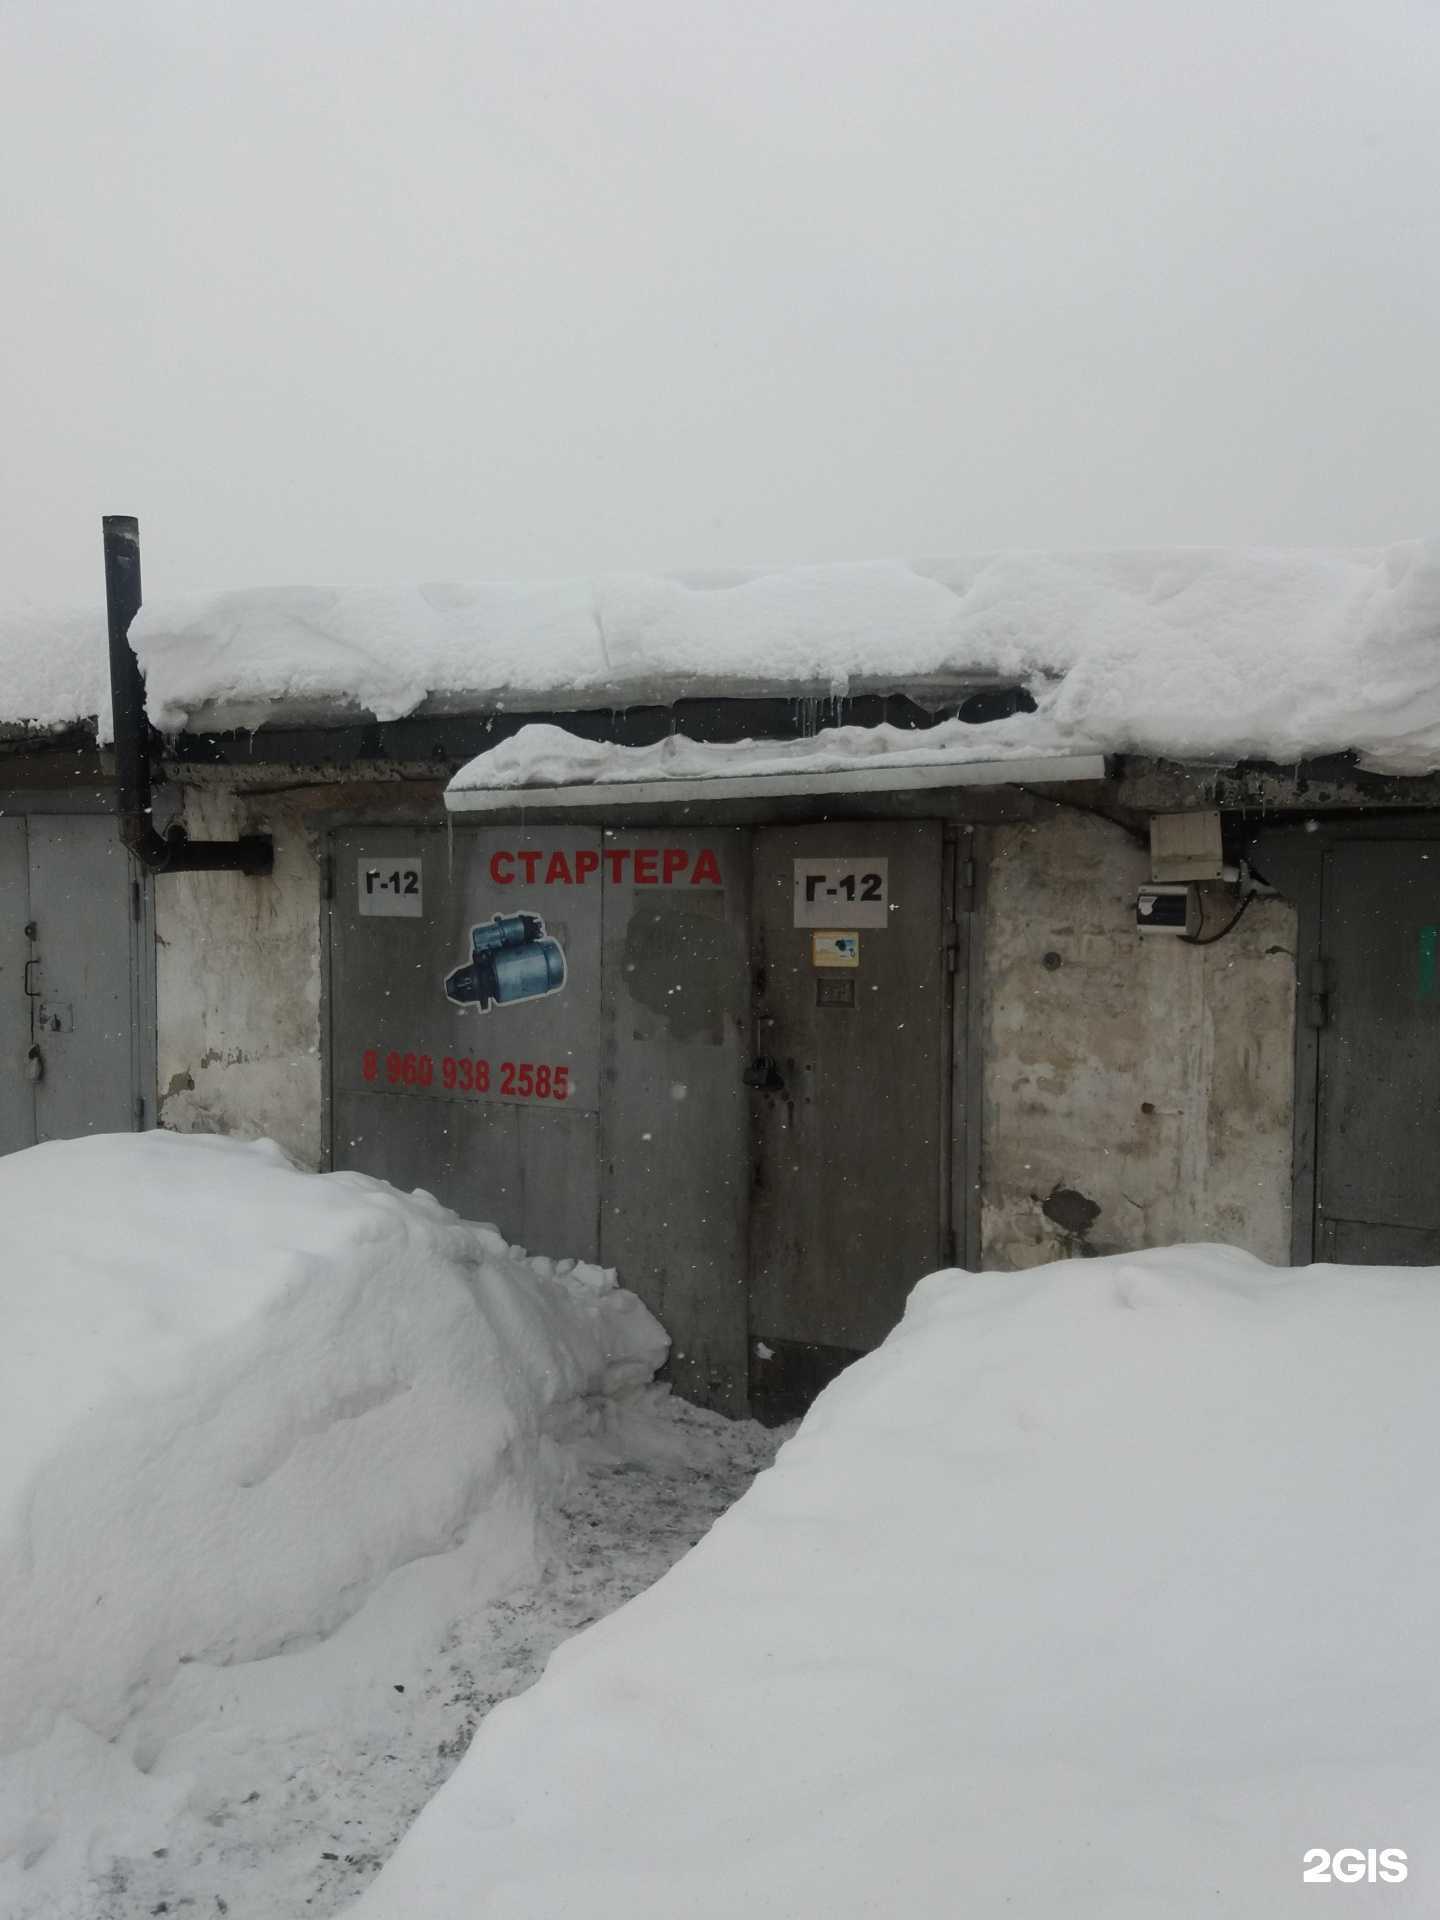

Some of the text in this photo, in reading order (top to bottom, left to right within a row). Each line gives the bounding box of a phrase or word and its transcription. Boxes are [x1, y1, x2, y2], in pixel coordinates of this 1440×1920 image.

[366, 870, 419, 894] Г-12
[489, 849, 722, 885] СТАРТЕРА
[805, 873, 883, 902] Г-12
[362, 1049, 569, 1100] 8 960 938 2585
